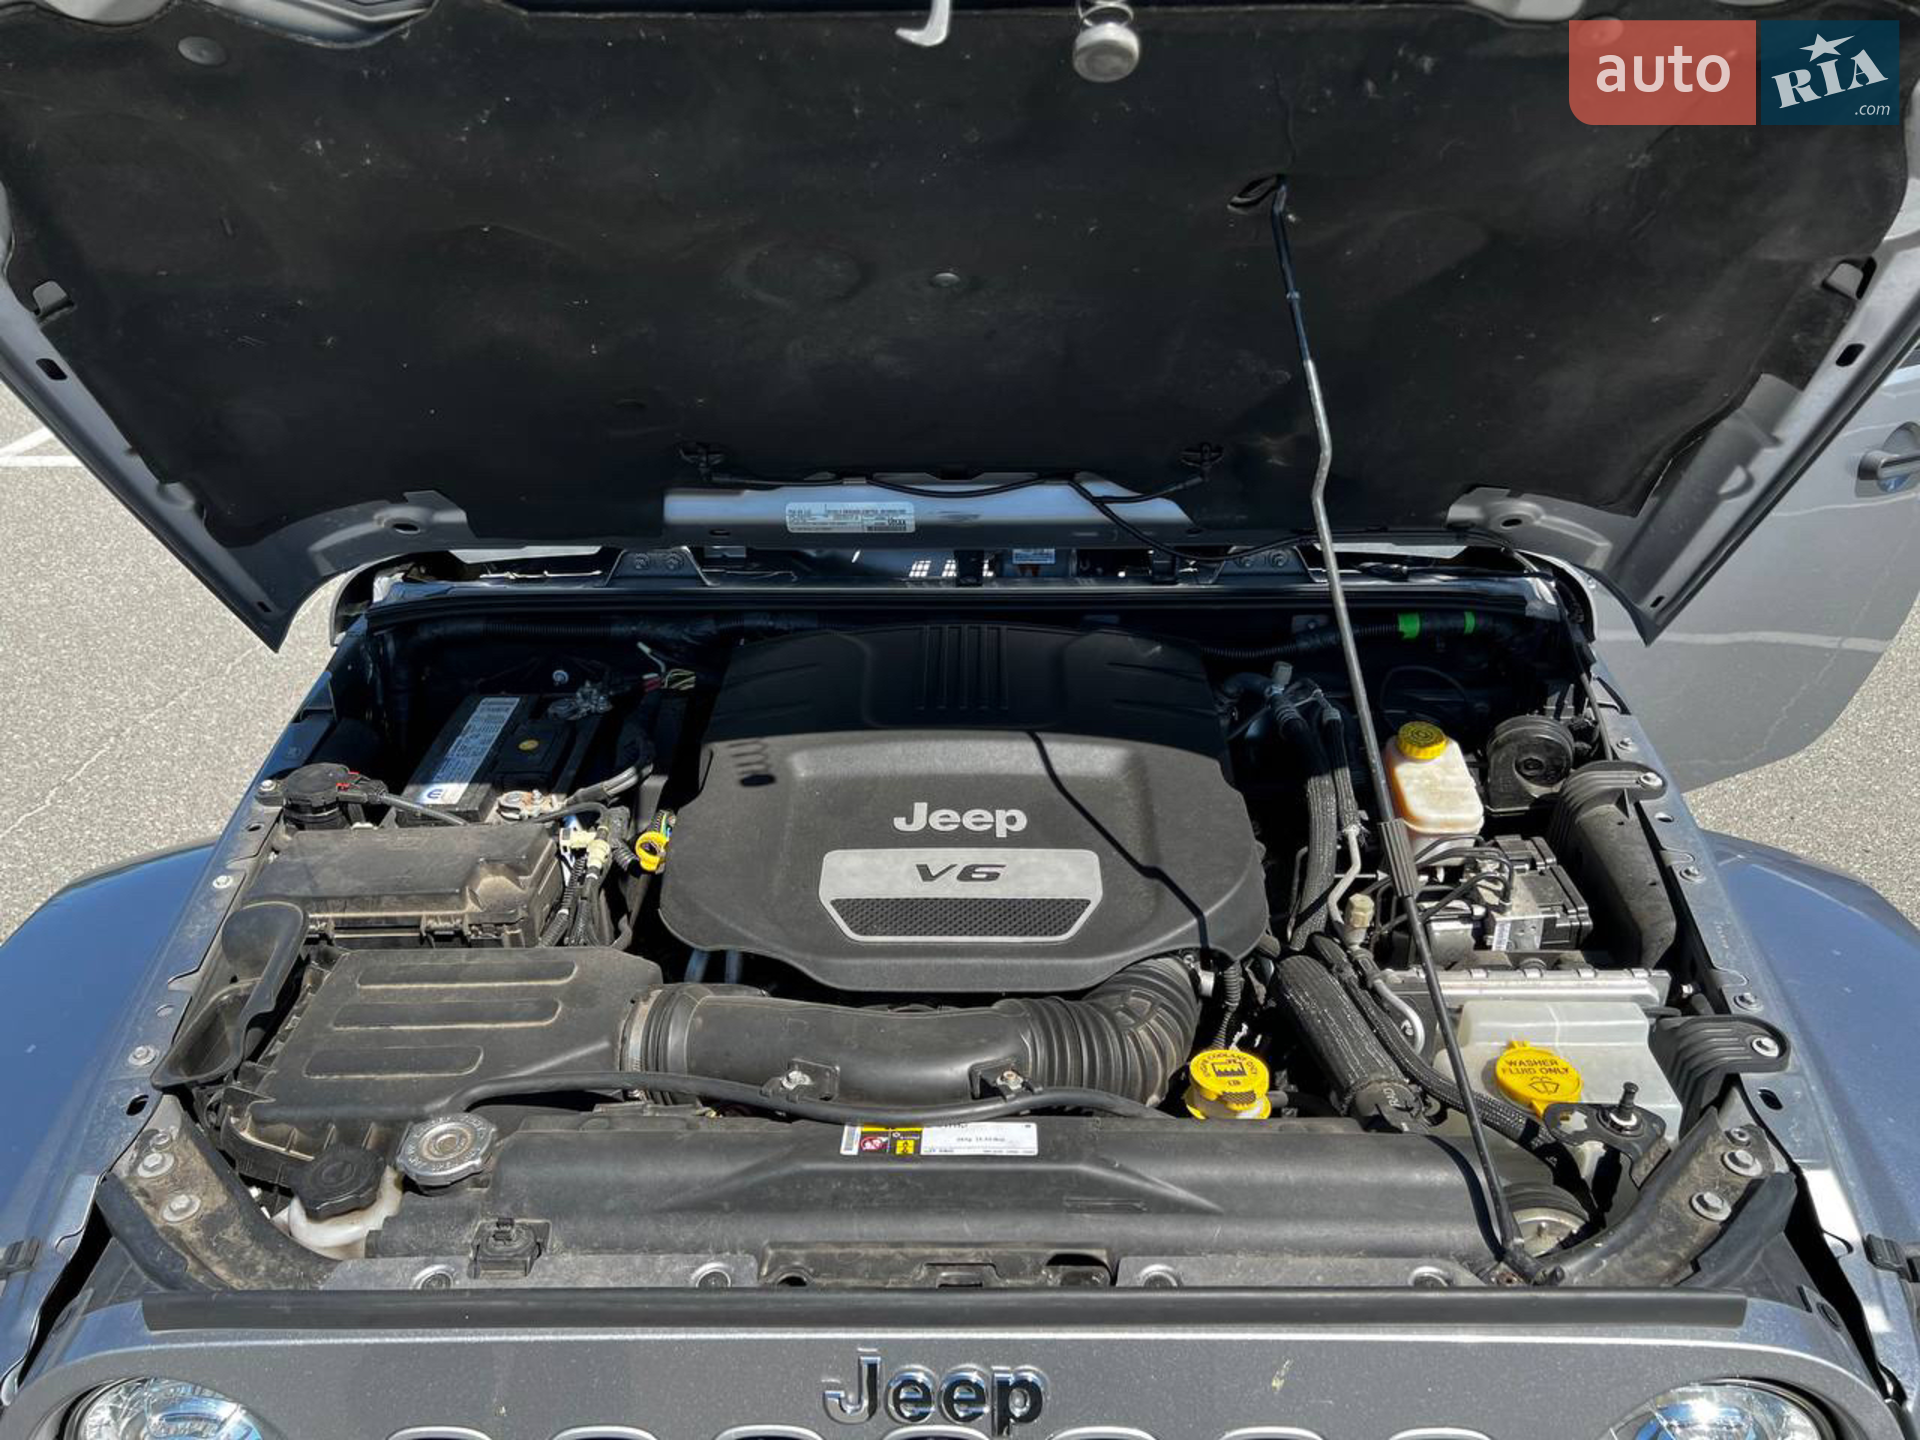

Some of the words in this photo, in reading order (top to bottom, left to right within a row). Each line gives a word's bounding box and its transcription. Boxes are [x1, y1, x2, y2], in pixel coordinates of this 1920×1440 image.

[893, 802, 1028, 838] Jeep
[915, 864, 1007, 882] V6
[1501, 1067, 1537, 1075] FLUID
[1539, 1067, 1570, 1075] ONLY
[1504, 1059, 1559, 1067] WASHER
[823, 1350, 1045, 1437] Jeep
